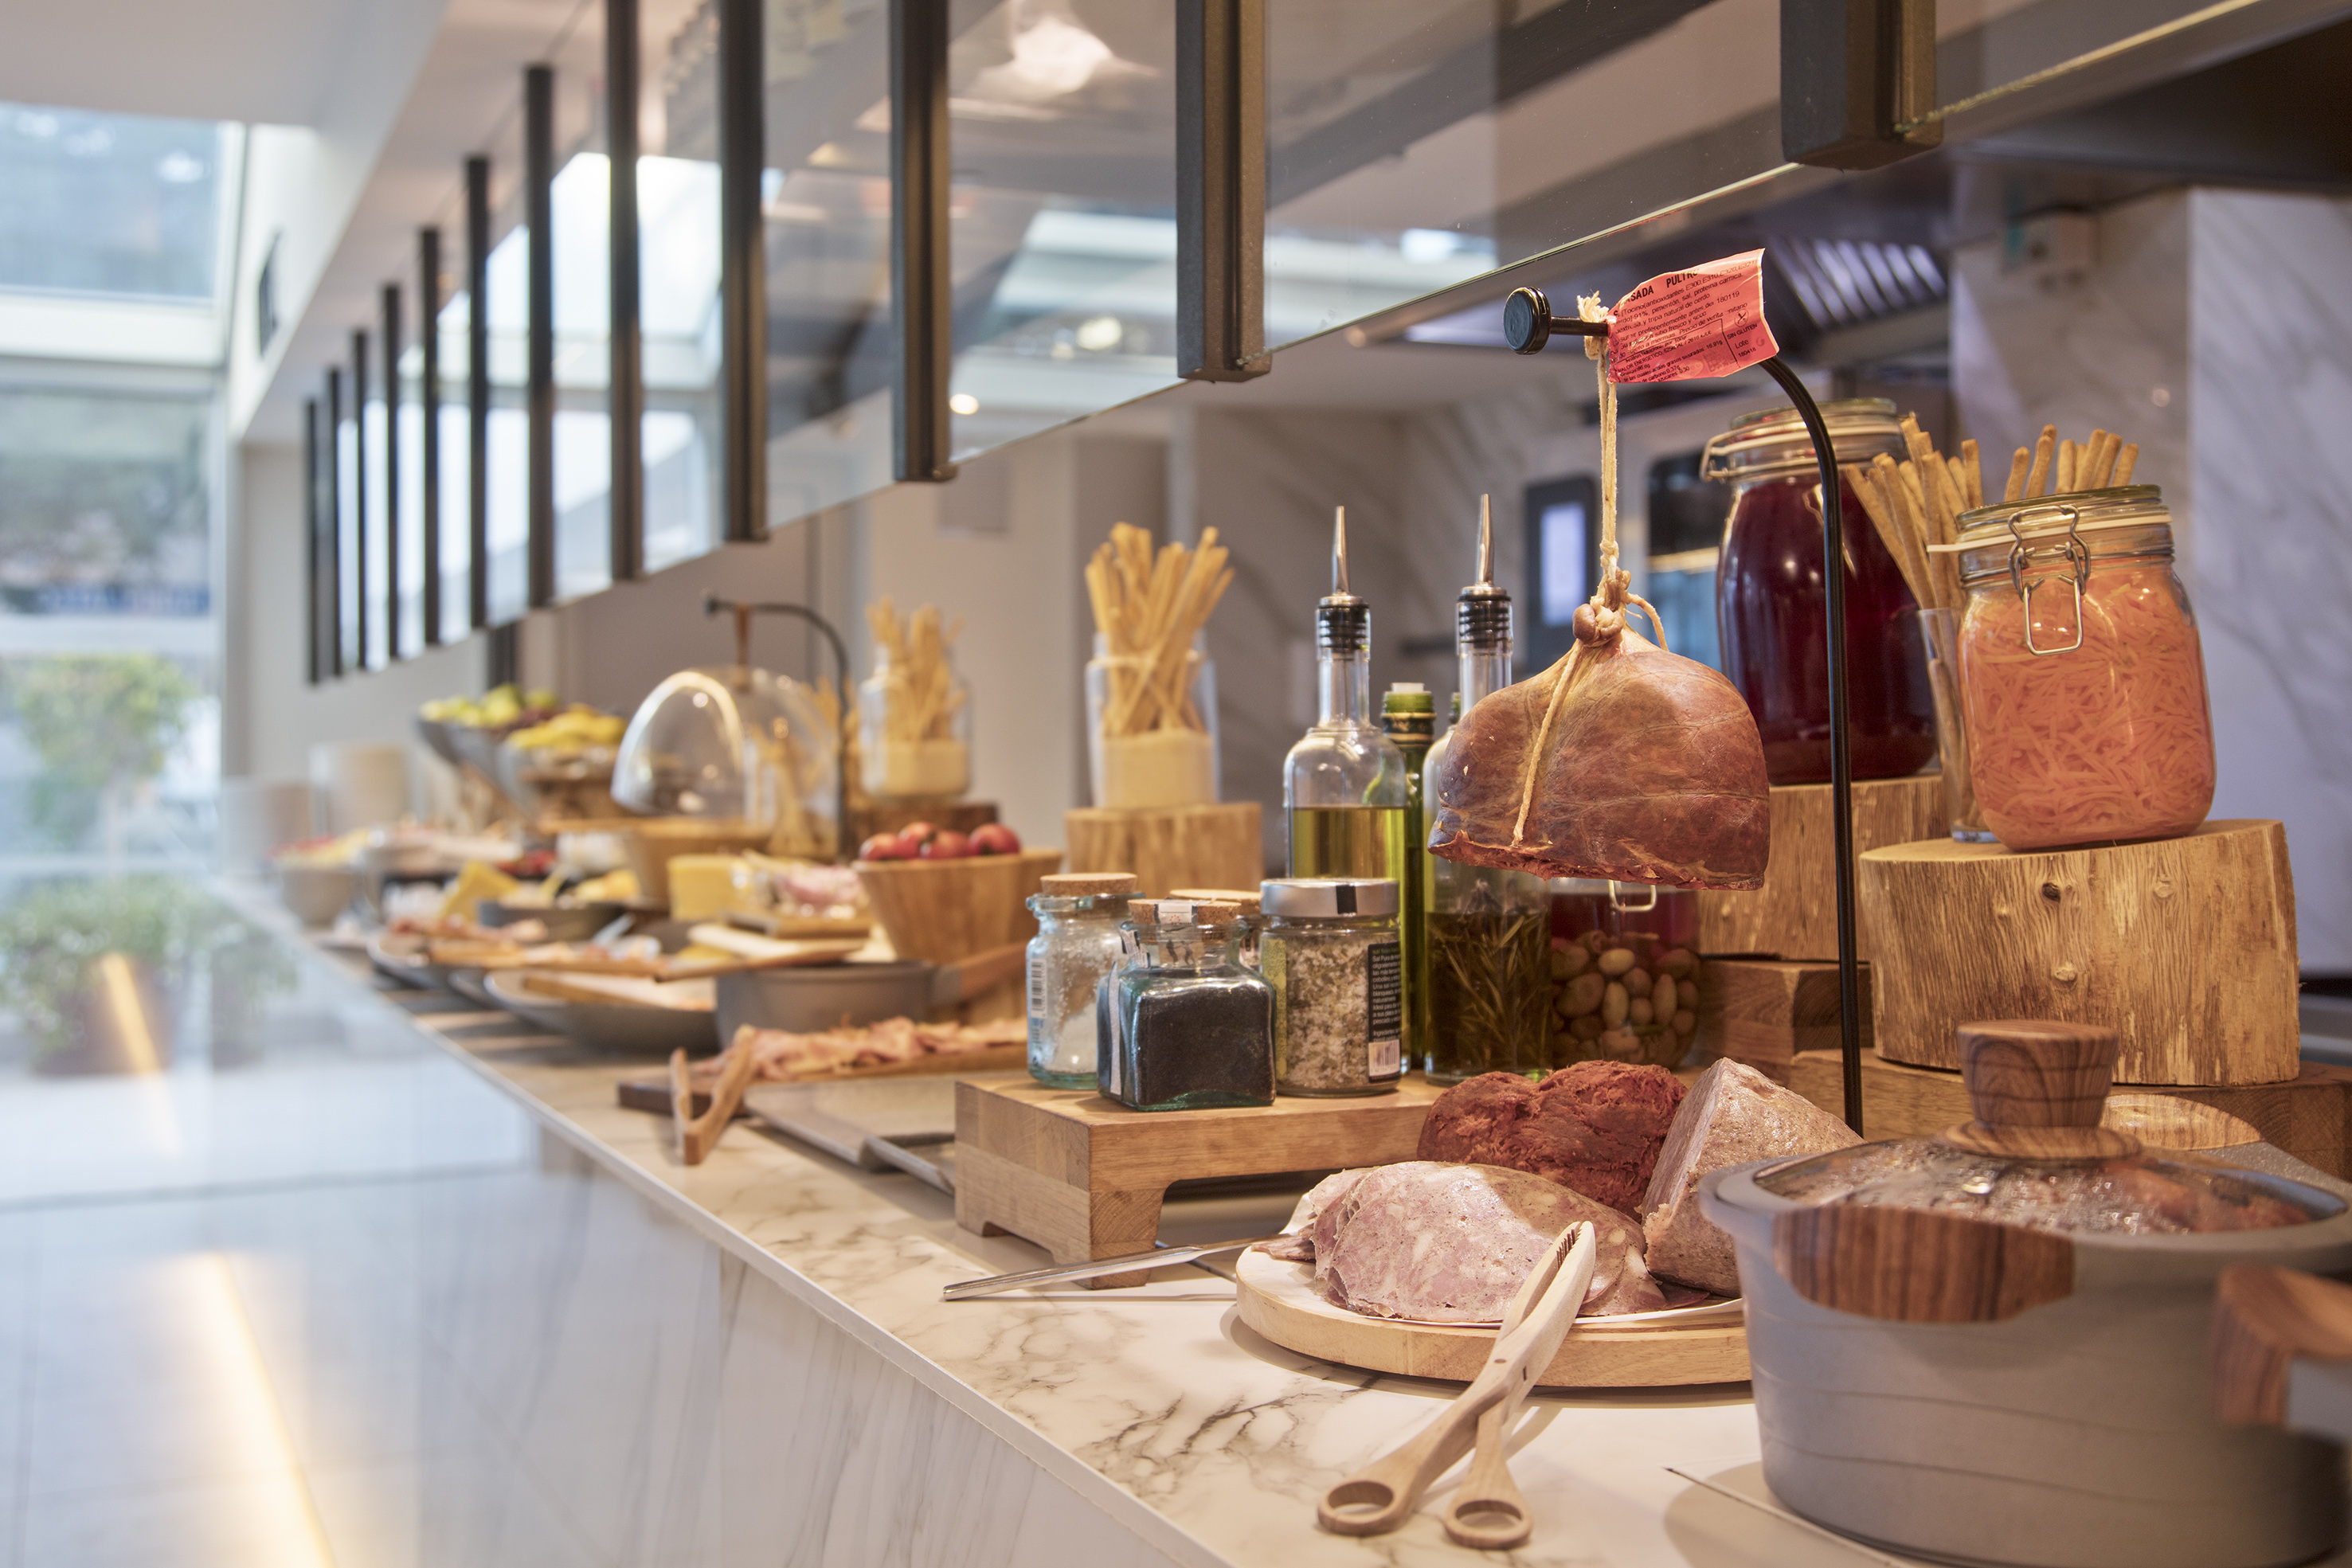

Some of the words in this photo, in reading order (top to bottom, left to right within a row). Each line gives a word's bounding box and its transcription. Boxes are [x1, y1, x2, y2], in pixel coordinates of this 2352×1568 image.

[1638, 314, 1687, 336] preferentemente
[1716, 291, 1740, 303] 180119
[1664, 304, 1685, 317] natural
[1679, 323, 1698, 334] Precio
[1727, 331, 1737, 340] SIN
[1736, 323, 1758, 335] GLUTEN
[1734, 339, 1750, 350] Lote
[1738, 346, 1757, 358] 180418
